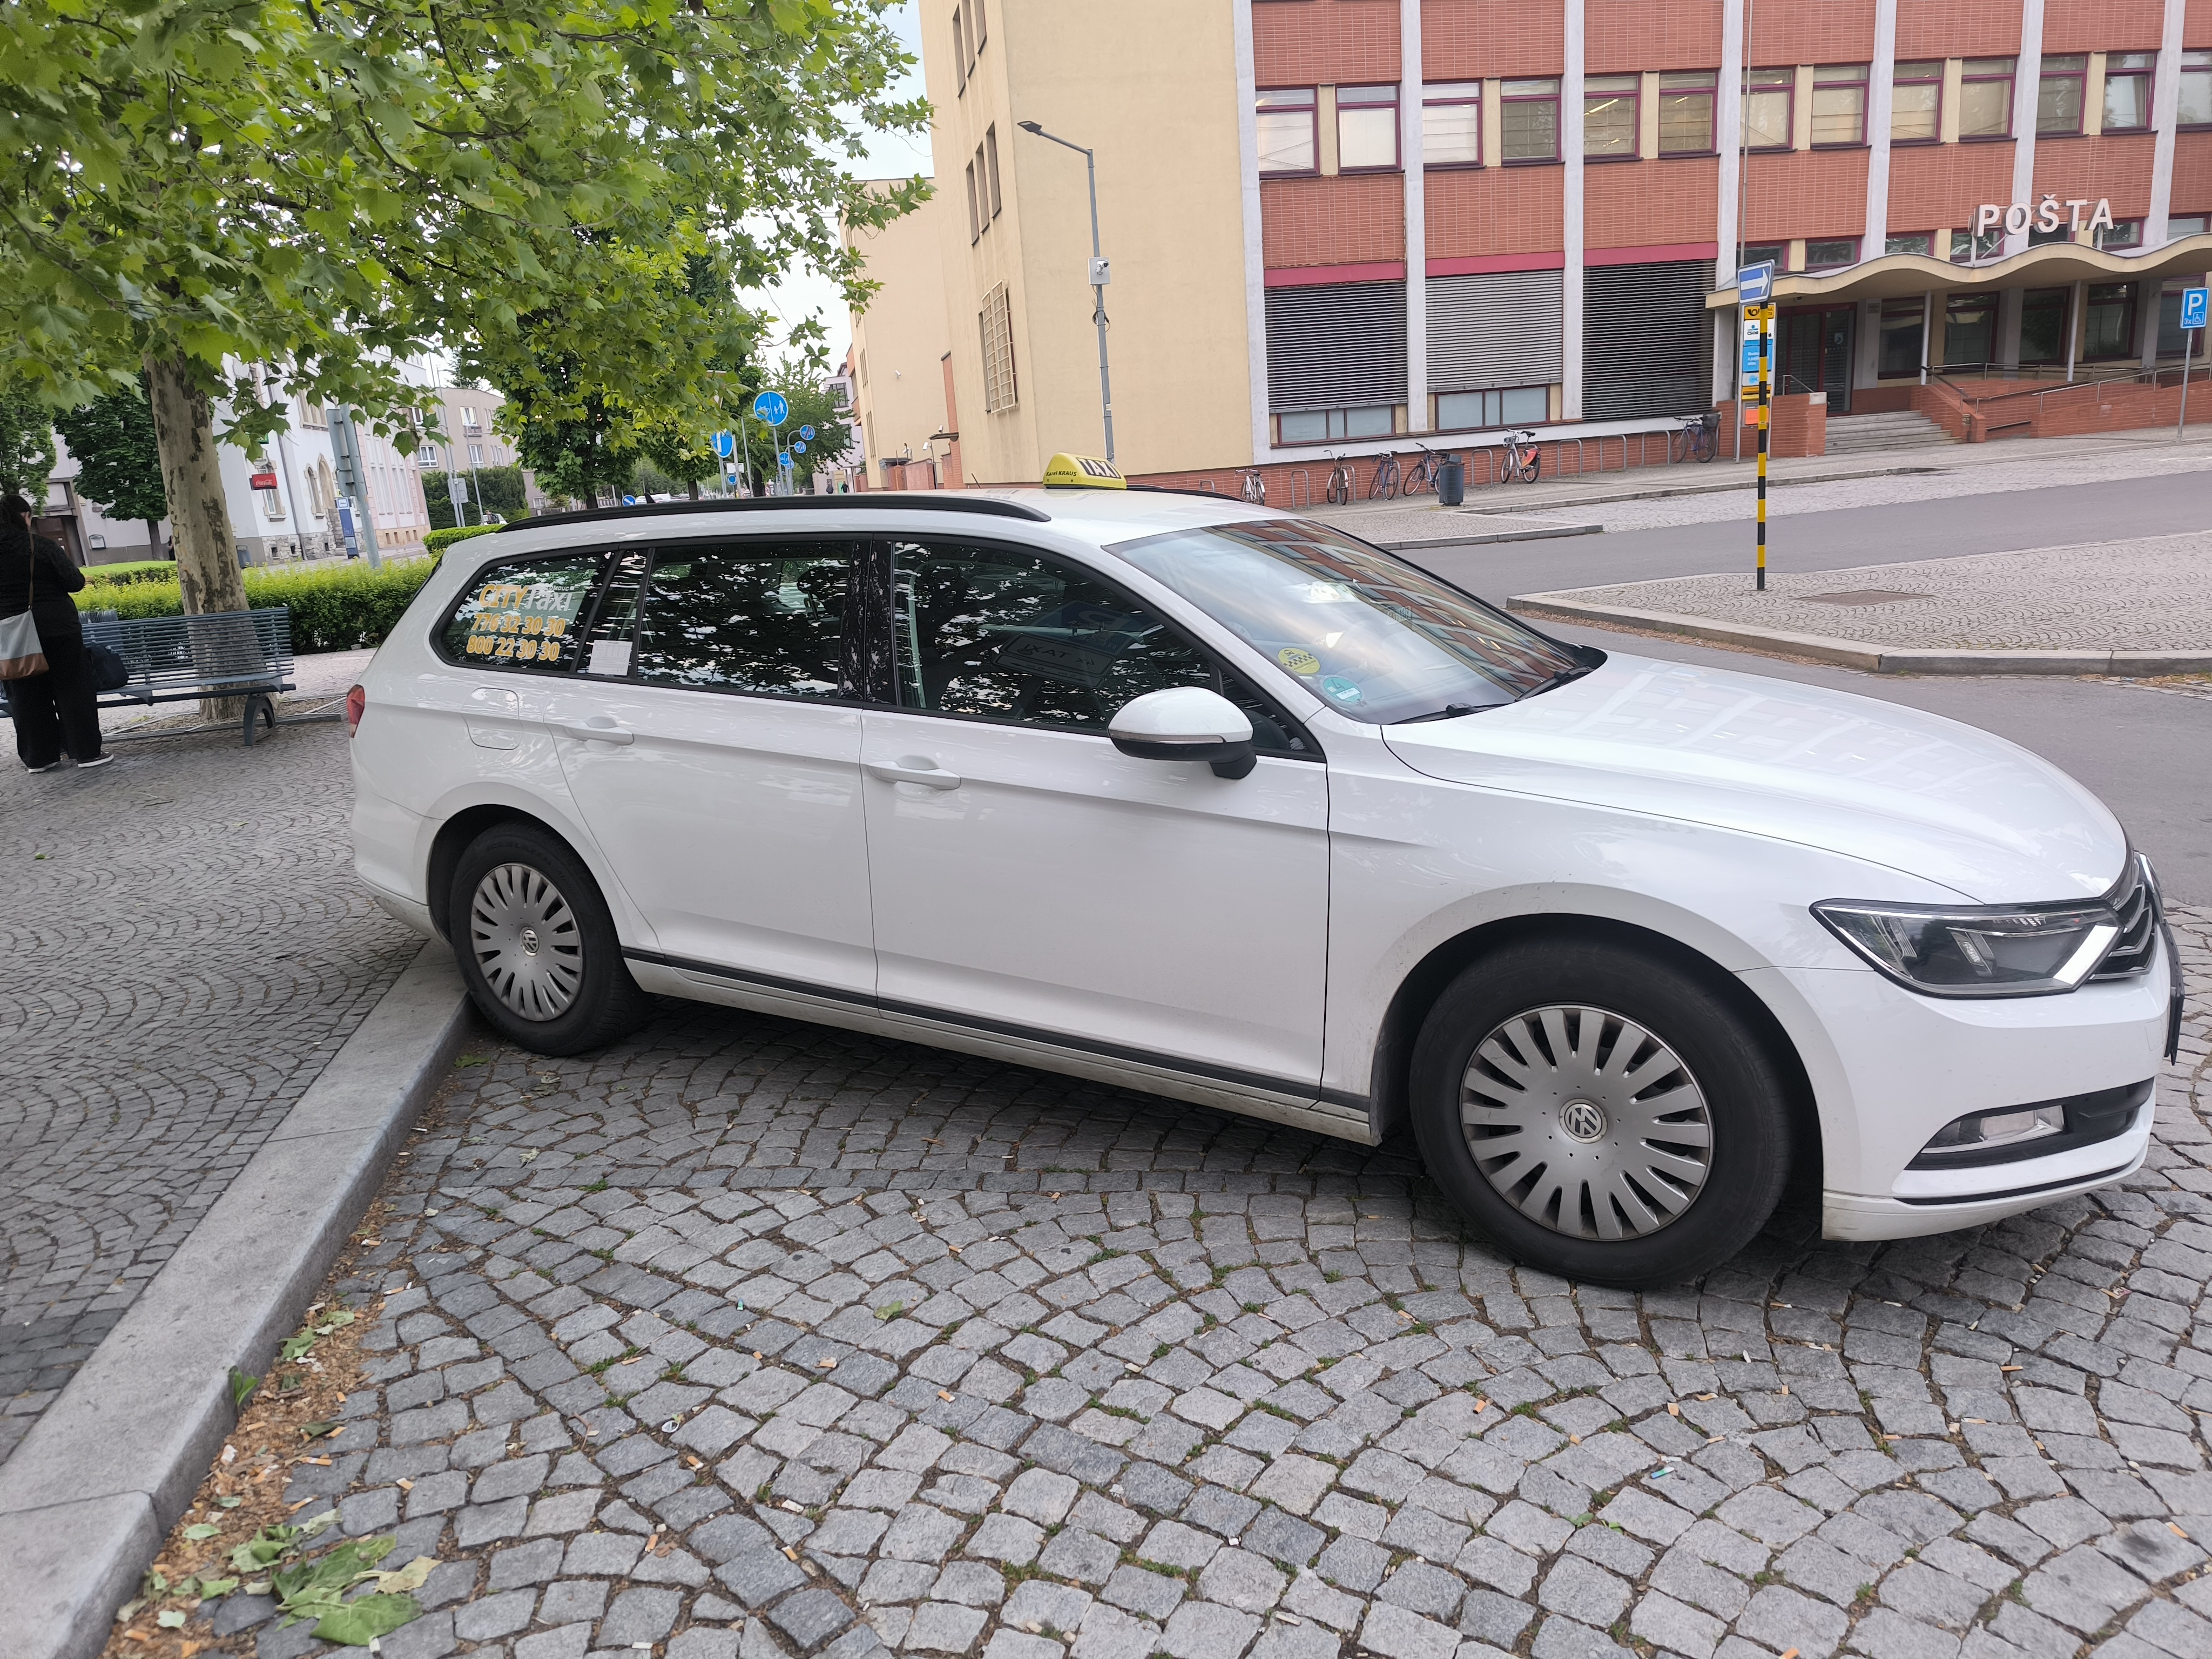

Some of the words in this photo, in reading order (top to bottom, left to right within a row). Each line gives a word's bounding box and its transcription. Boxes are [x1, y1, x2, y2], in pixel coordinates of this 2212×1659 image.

[1974, 193, 2114, 237] POŠTA
[2187, 293, 2203, 316] P
[1076, 457, 1121, 478] TAXI
[471, 612, 501, 632] 776
[500, 614, 521, 633] 32
[521, 616, 543, 636] 30
[544, 617, 566, 637] 30
[466, 635, 494, 655] 800
[495, 637, 516, 657] 22
[516, 639, 537, 659] 30
[538, 641, 561, 662] 30
[1330, 679, 1345, 689] 4
